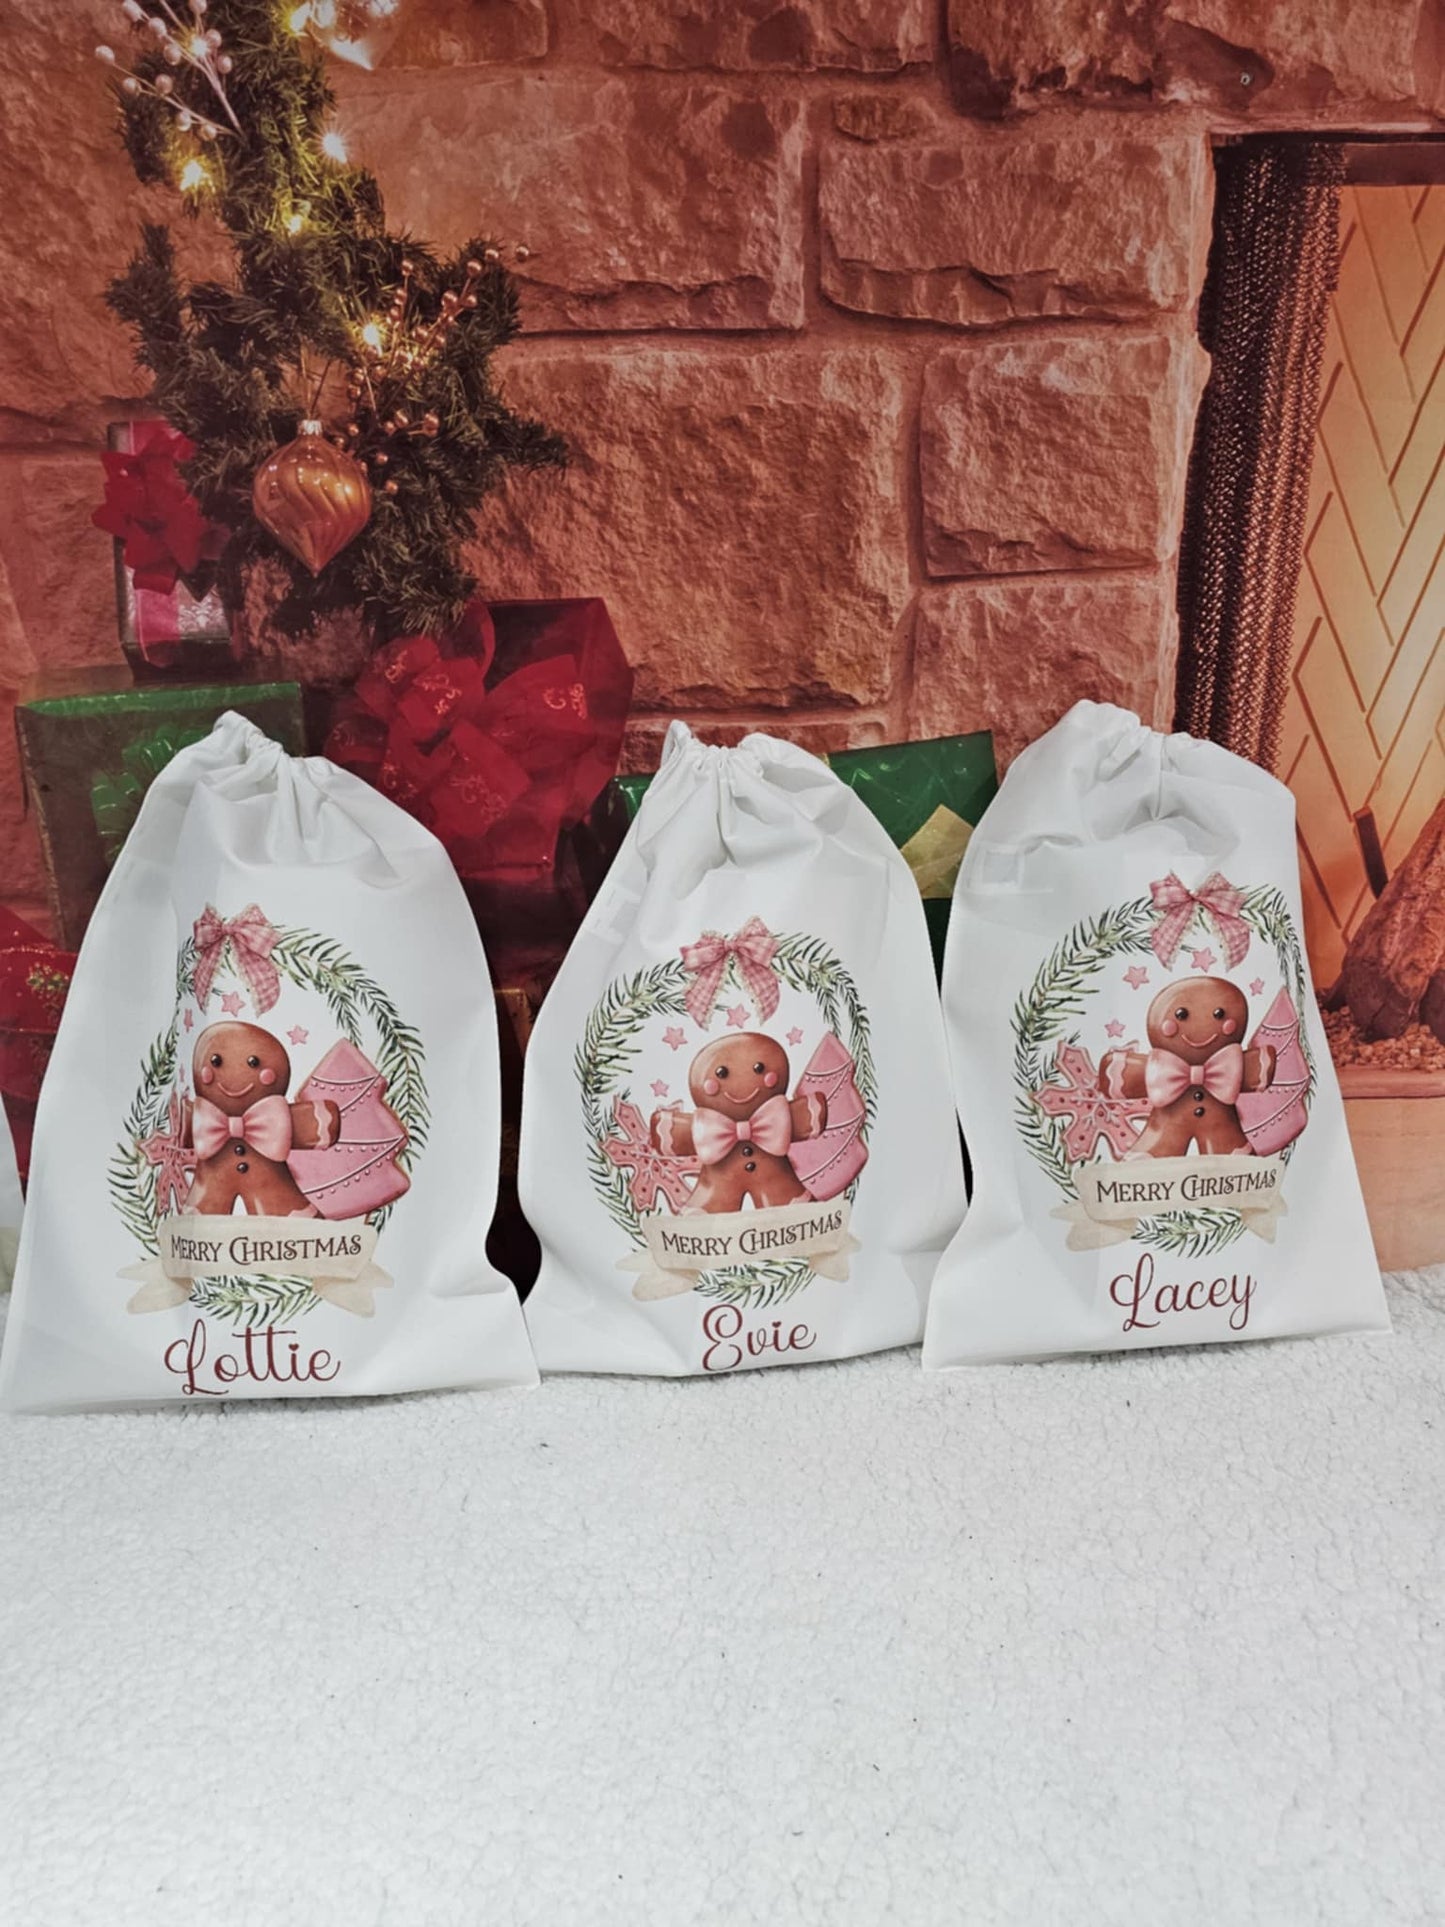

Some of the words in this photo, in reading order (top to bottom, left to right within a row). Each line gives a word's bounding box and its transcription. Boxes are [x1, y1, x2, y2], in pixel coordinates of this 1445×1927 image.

[1097, 1180, 1176, 1203] MERRY
[1181, 1169, 1277, 1200] CHRISTMAS
[171, 1234, 223, 1262] MERRY
[229, 1234, 362, 1265] CHRISTMAS
[661, 1231, 732, 1256] MERRY
[739, 1210, 842, 1254] CHRISTMAS
[1109, 1253, 1257, 1332] Lacey
[164, 1318, 341, 1395] Lottie
[702, 1304, 817, 1372] Evie
